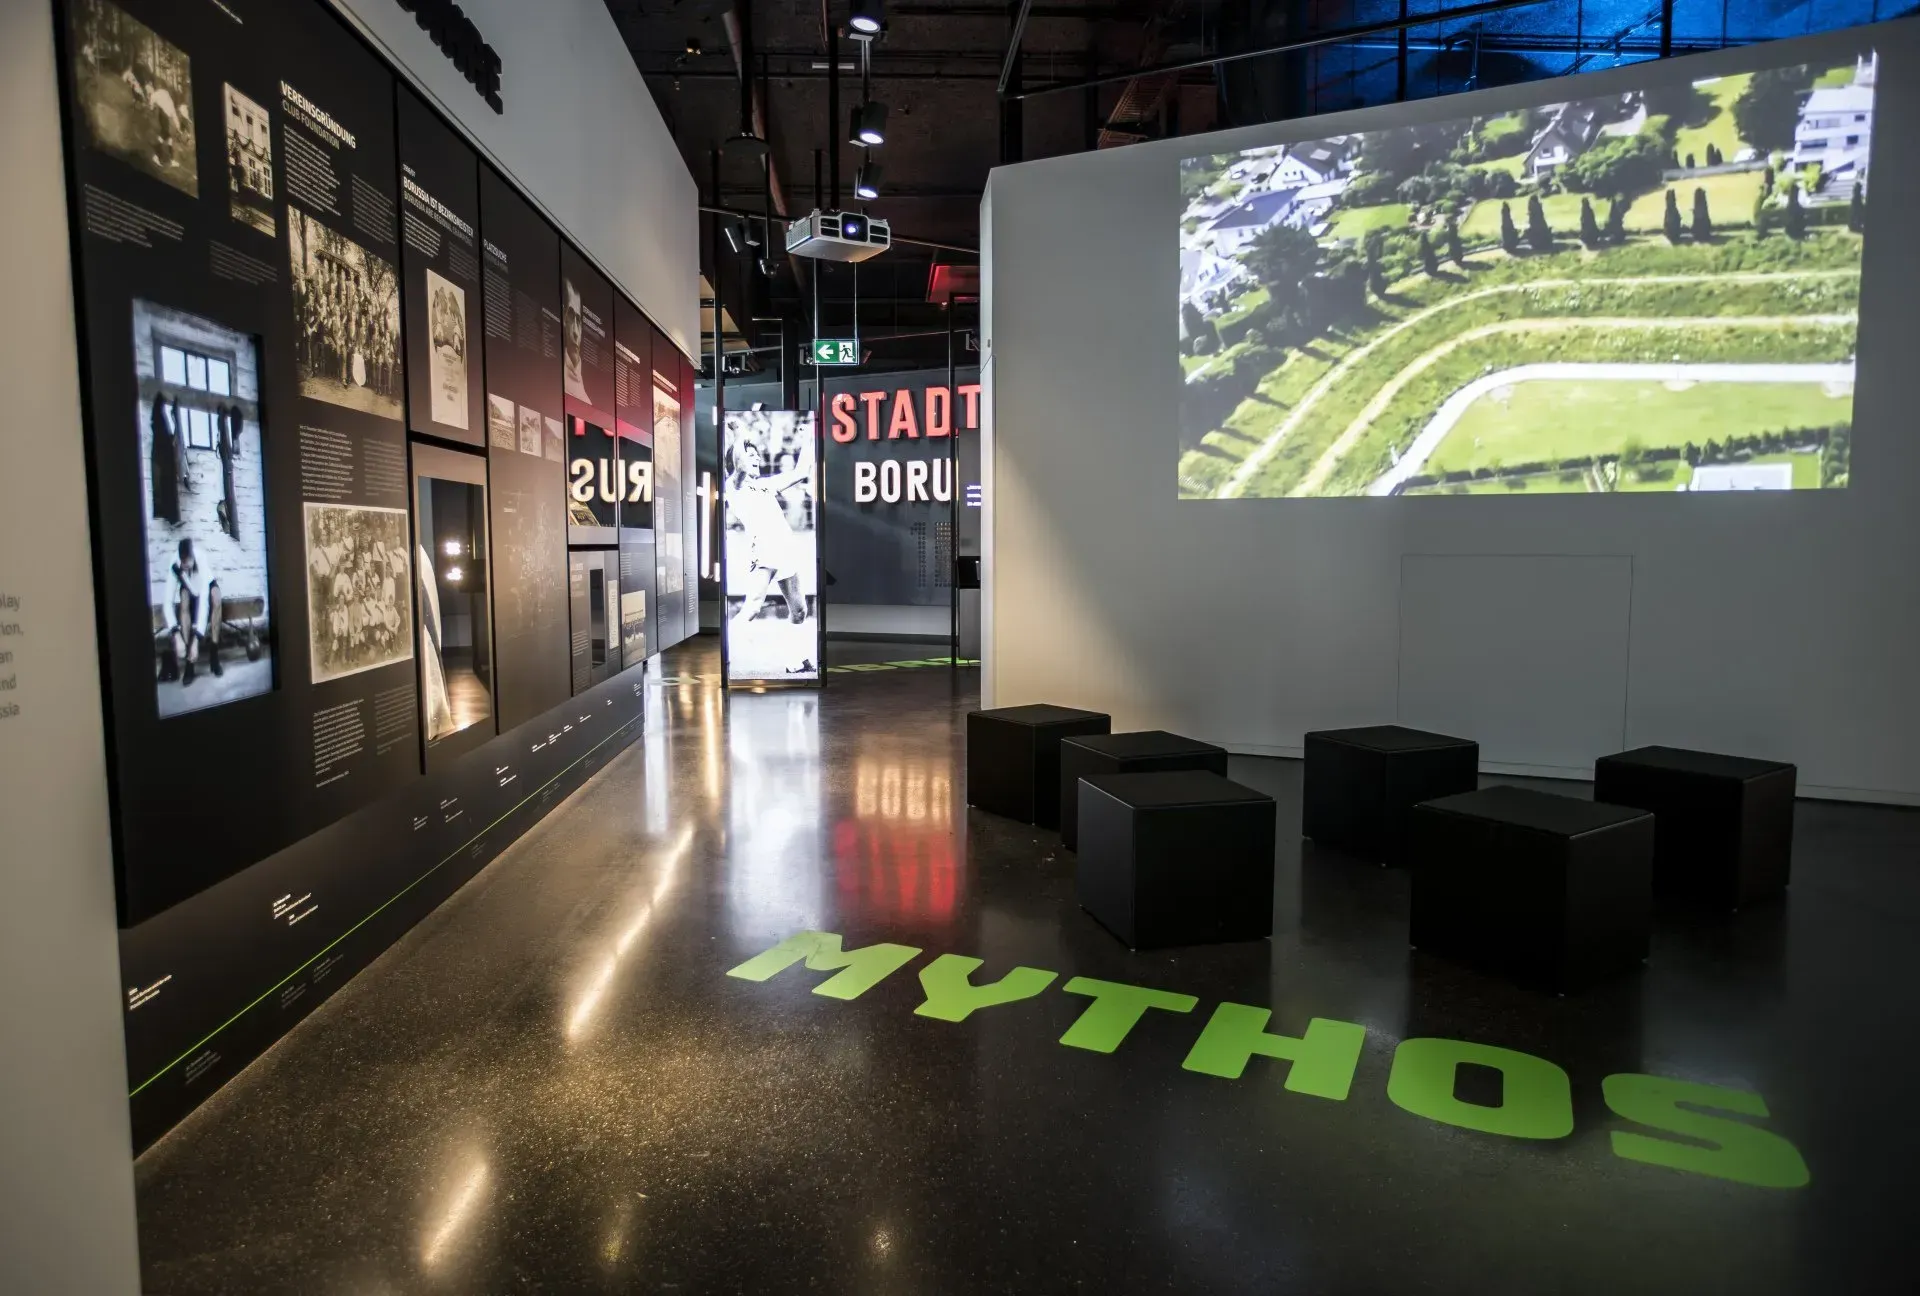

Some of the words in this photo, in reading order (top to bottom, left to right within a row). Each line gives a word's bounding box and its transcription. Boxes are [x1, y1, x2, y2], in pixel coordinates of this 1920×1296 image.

[281, 80, 356, 149] VEREINSGRÜNDUNG
[282, 99, 300, 120] CLUB
[301, 113, 340, 149] FOUNDATION
[832, 384, 981, 444] STADT
[855, 457, 951, 503] BORU
[726, 929, 1810, 1188] MYTHOS
